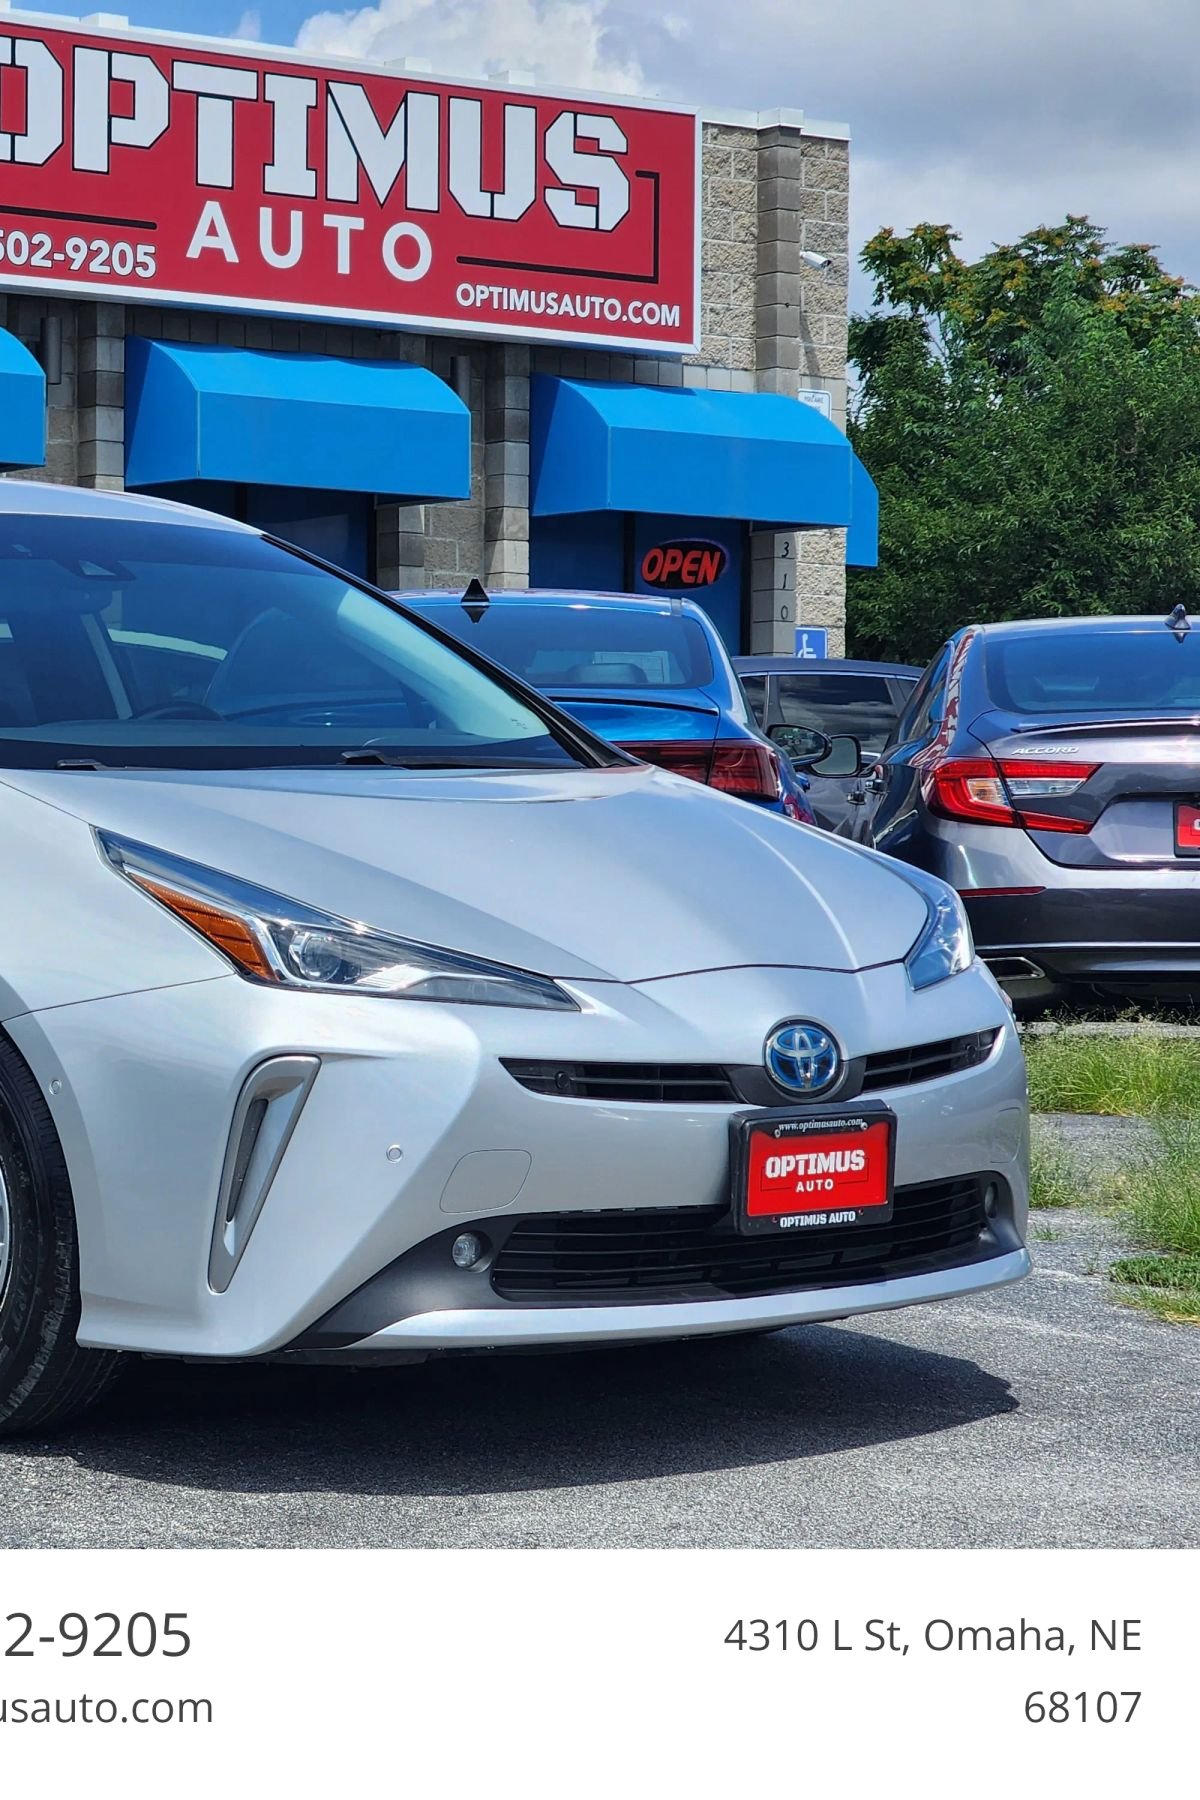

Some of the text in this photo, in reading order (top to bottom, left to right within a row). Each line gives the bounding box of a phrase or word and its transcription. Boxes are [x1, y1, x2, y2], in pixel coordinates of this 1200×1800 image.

[186, 200, 434, 283] AUTO
[455, 283, 681, 329] OPTIMUSAUTO.COM
[641, 548, 721, 585] OPEN
[1011, 746, 1080, 755] ACCORD
[778, 1118, 863, 1132] www.optimusauto.com
[765, 1150, 865, 1179] OPTIMUS
[796, 1178, 834, 1193] AUTO
[780, 1211, 856, 1228] OPTIMUS AUTO
